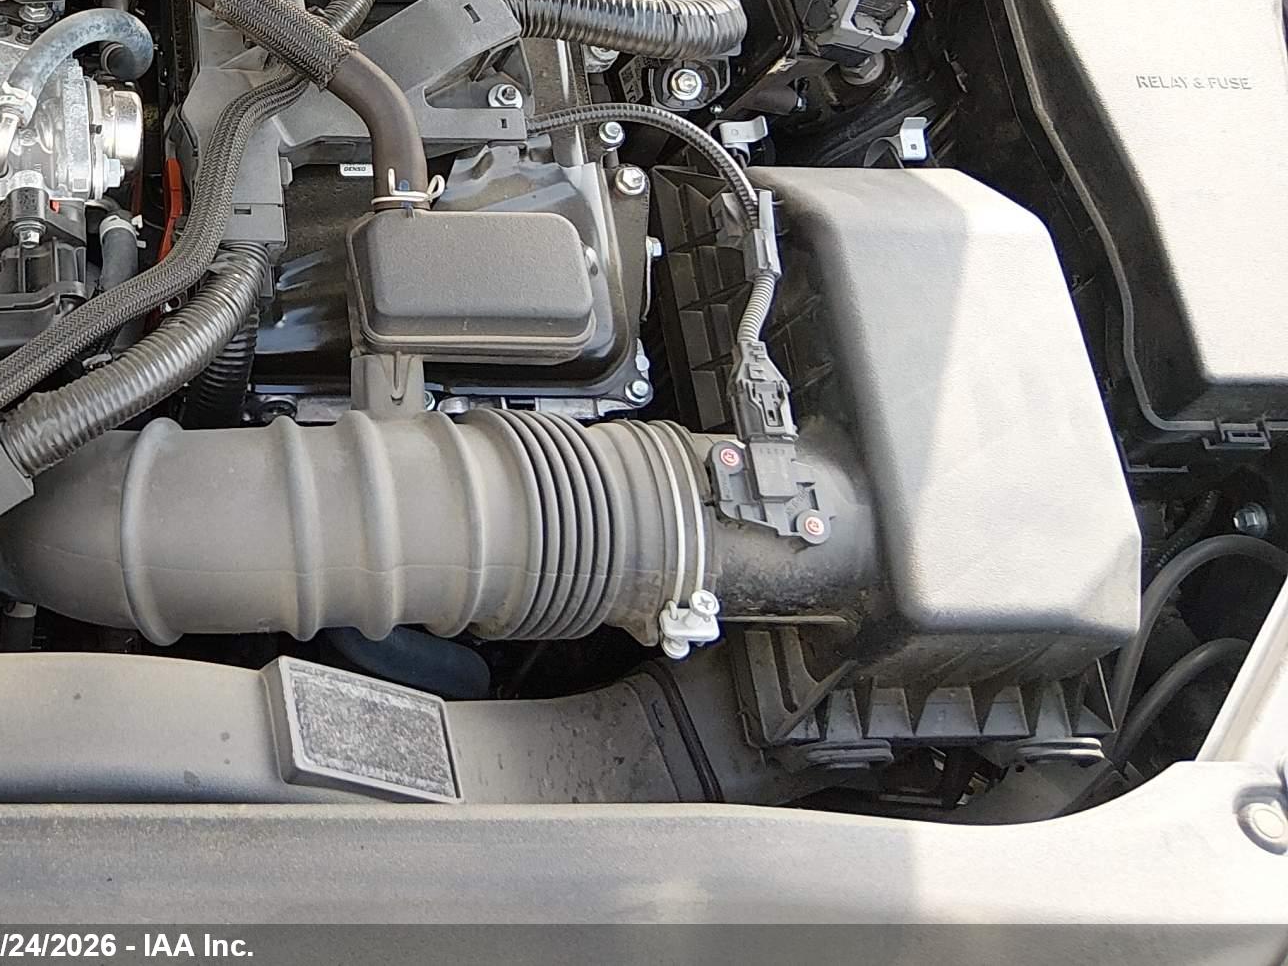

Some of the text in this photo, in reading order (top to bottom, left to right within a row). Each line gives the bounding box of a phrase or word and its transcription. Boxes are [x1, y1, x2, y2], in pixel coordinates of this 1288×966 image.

[1135, 74, 1253, 91] RELAY & FUSE
